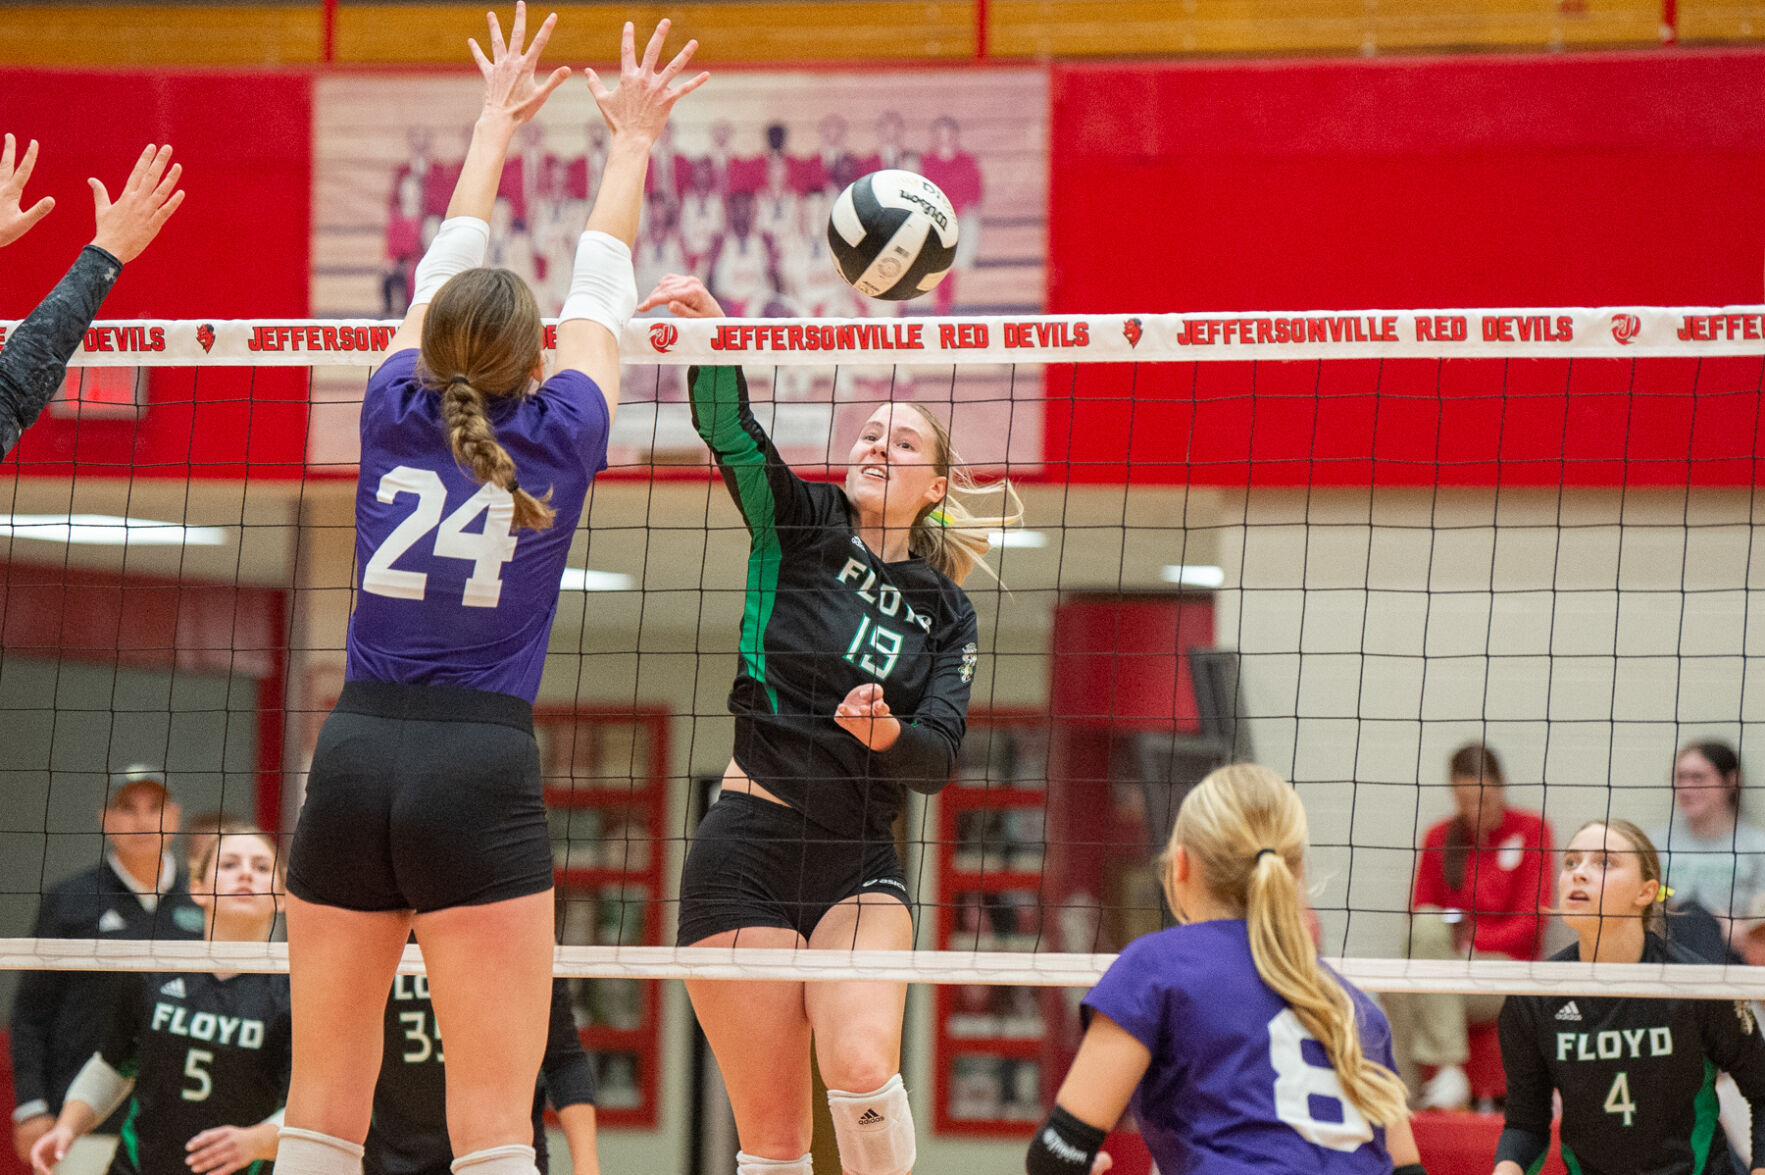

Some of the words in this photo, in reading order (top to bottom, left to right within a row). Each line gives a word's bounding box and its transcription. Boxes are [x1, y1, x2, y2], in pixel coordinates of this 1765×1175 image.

[899, 189, 948, 231] Wilson
[83, 326, 166, 352] DEVILS
[710, 324, 924, 351] JEFFERSONVILLE
[938, 323, 989, 349] RED
[1004, 321, 1090, 348] DEVILS
[1176, 316, 1399, 345] JEFFERSONVILLE
[1414, 316, 1467, 342] RED
[1482, 315, 1573, 342] DEVILS
[1677, 314, 1765, 341] JEFFE
[362, 465, 518, 608] 24
[842, 613, 904, 681] 19
[152, 1002, 264, 1050] FLOYD
[1556, 1026, 1673, 1062] FLOYD
[181, 1049, 214, 1101] 5
[1267, 1008, 1374, 1153] 8
[1603, 1072, 1637, 1127] 4
[858, 1116, 885, 1126] adidas
